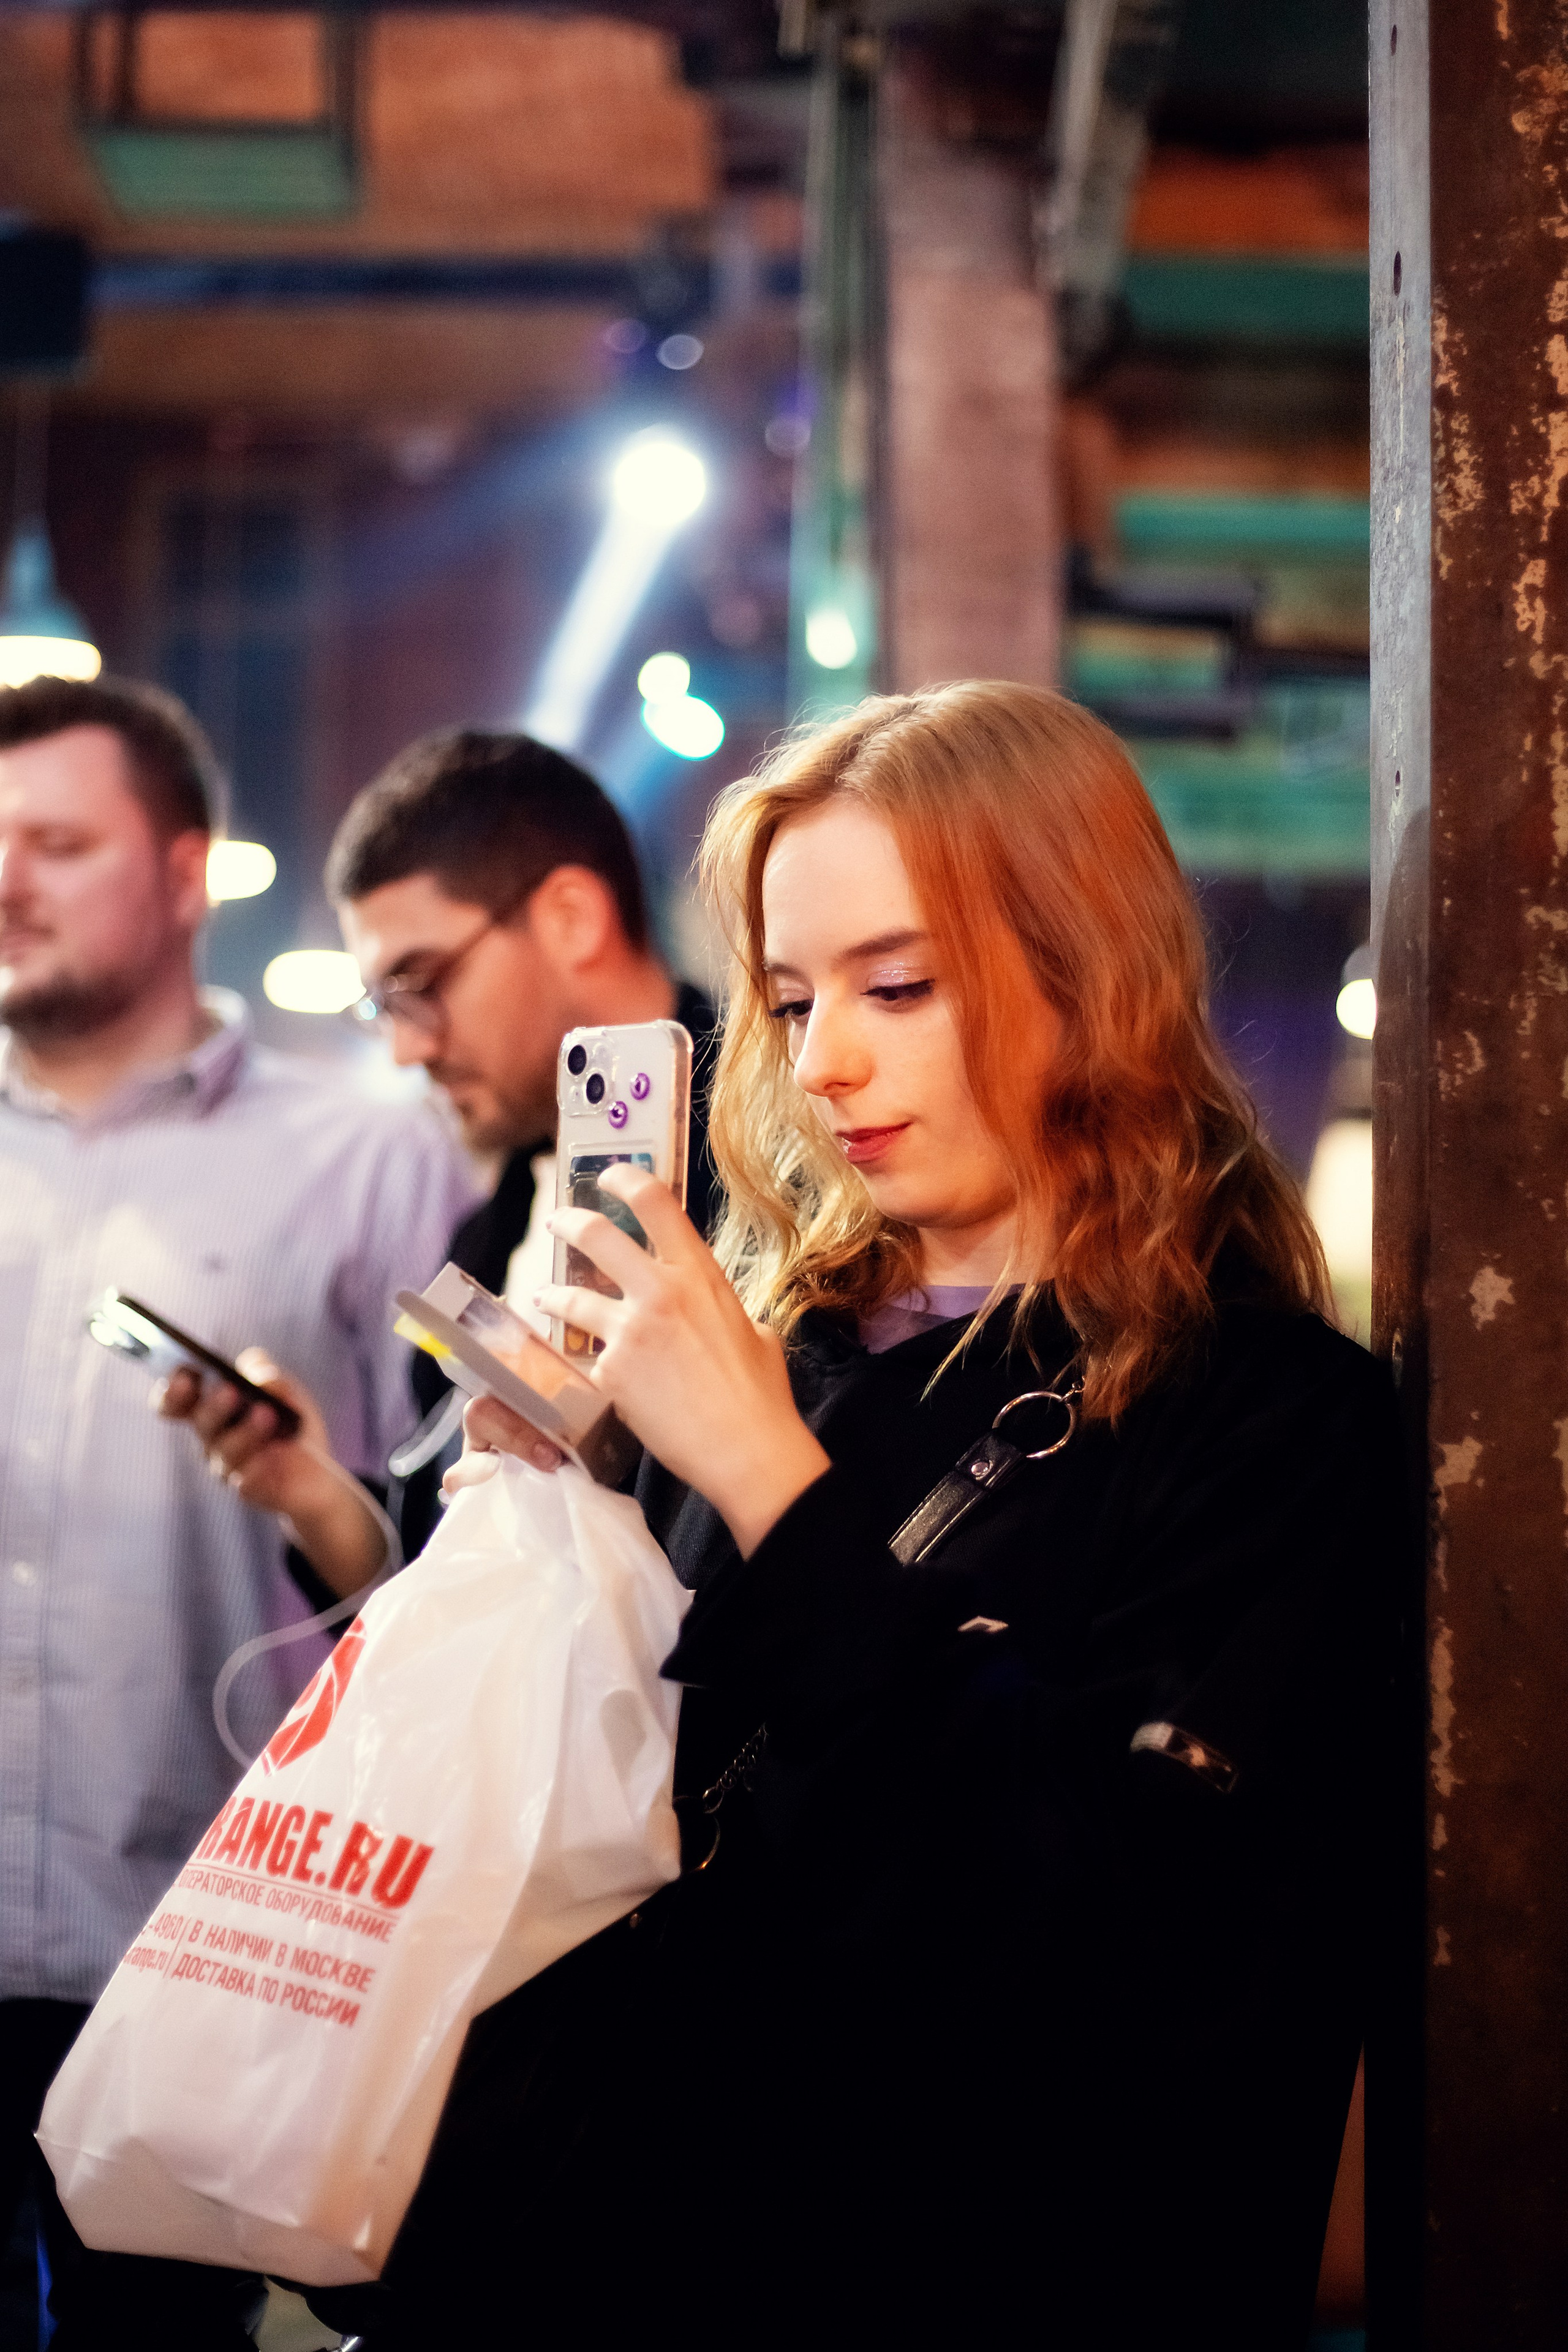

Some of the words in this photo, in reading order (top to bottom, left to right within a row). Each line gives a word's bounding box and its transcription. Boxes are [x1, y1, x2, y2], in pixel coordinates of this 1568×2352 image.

[141, 1913, 184, 1940] -4960
[265, 1888, 397, 1943] ОБОРУДОВАНИЕ
[188, 1920, 203, 1942] В
[203, 1924, 273, 1962] НАЛИЧИИ
[275, 1943, 288, 1967] В
[290, 1947, 375, 1993] МОСКВЕ
[171, 1953, 255, 1996] ДОСТАВКА
[259, 1976, 279, 2003] ПО
[279, 1983, 361, 2028] РОССИИ
